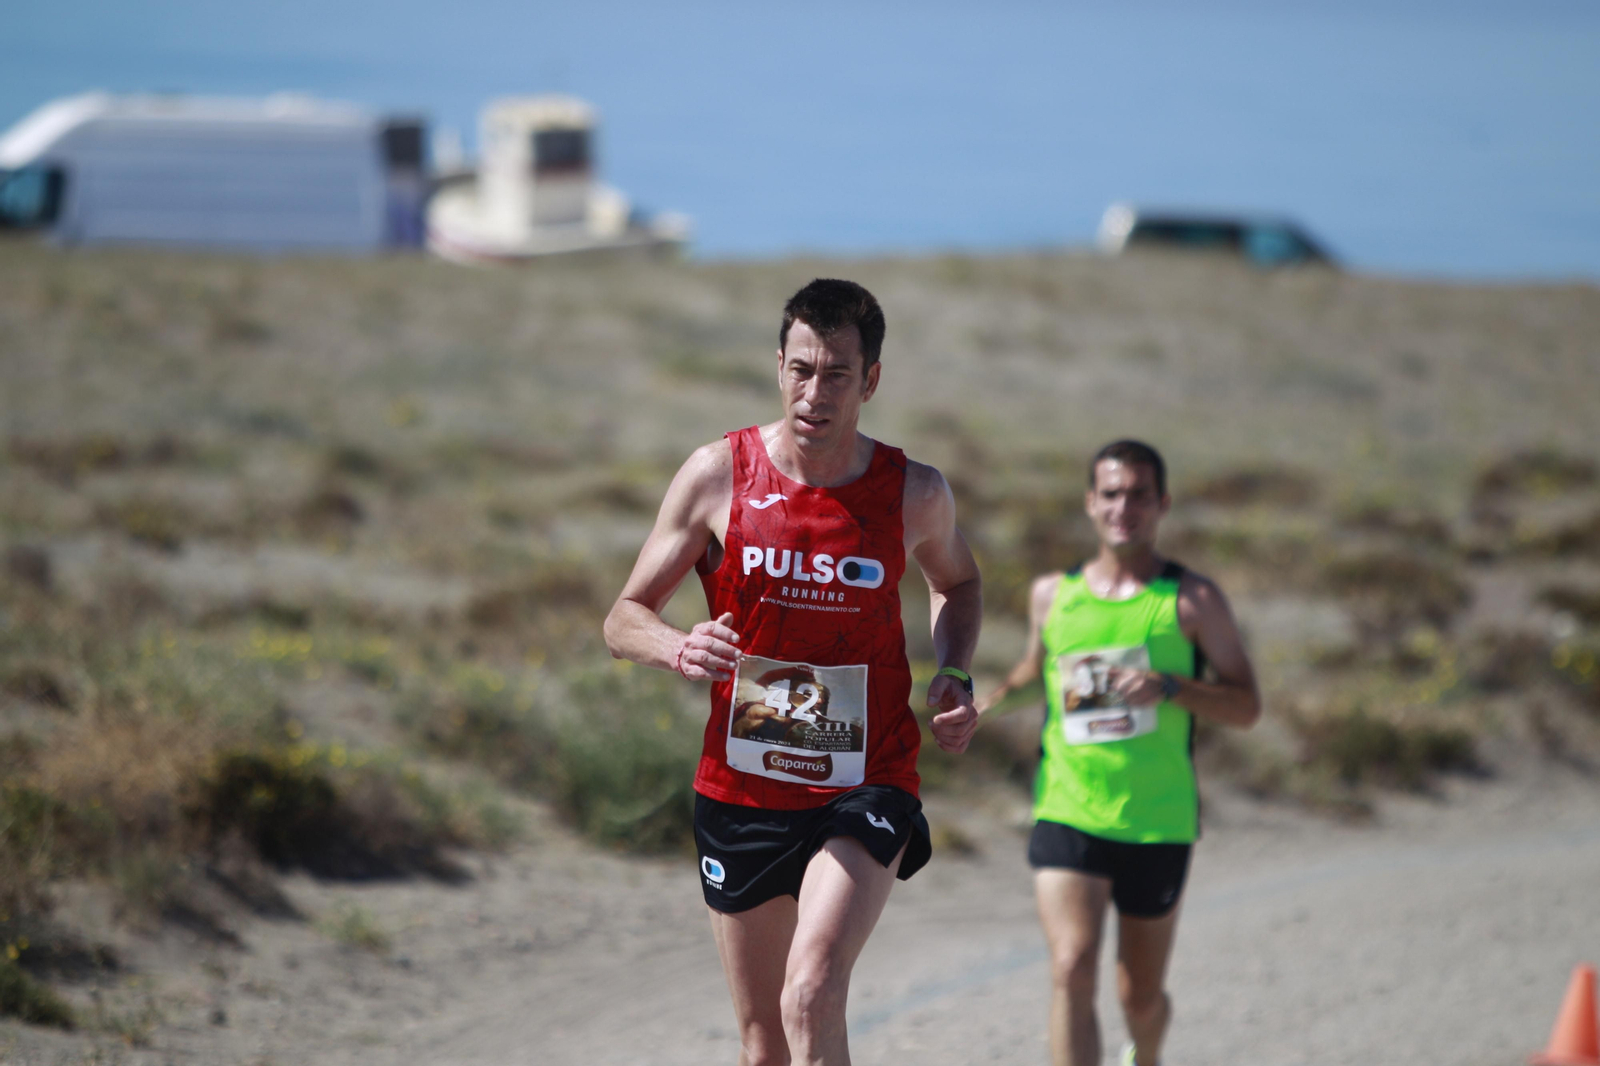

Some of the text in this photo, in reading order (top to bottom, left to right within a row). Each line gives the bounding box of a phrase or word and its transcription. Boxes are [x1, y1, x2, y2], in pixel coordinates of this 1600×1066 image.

[742, 546, 885, 589] PULSO
[781, 586, 845, 602] RUNNING
[765, 679, 819, 723] 42
[805, 721, 852, 732] XIII
